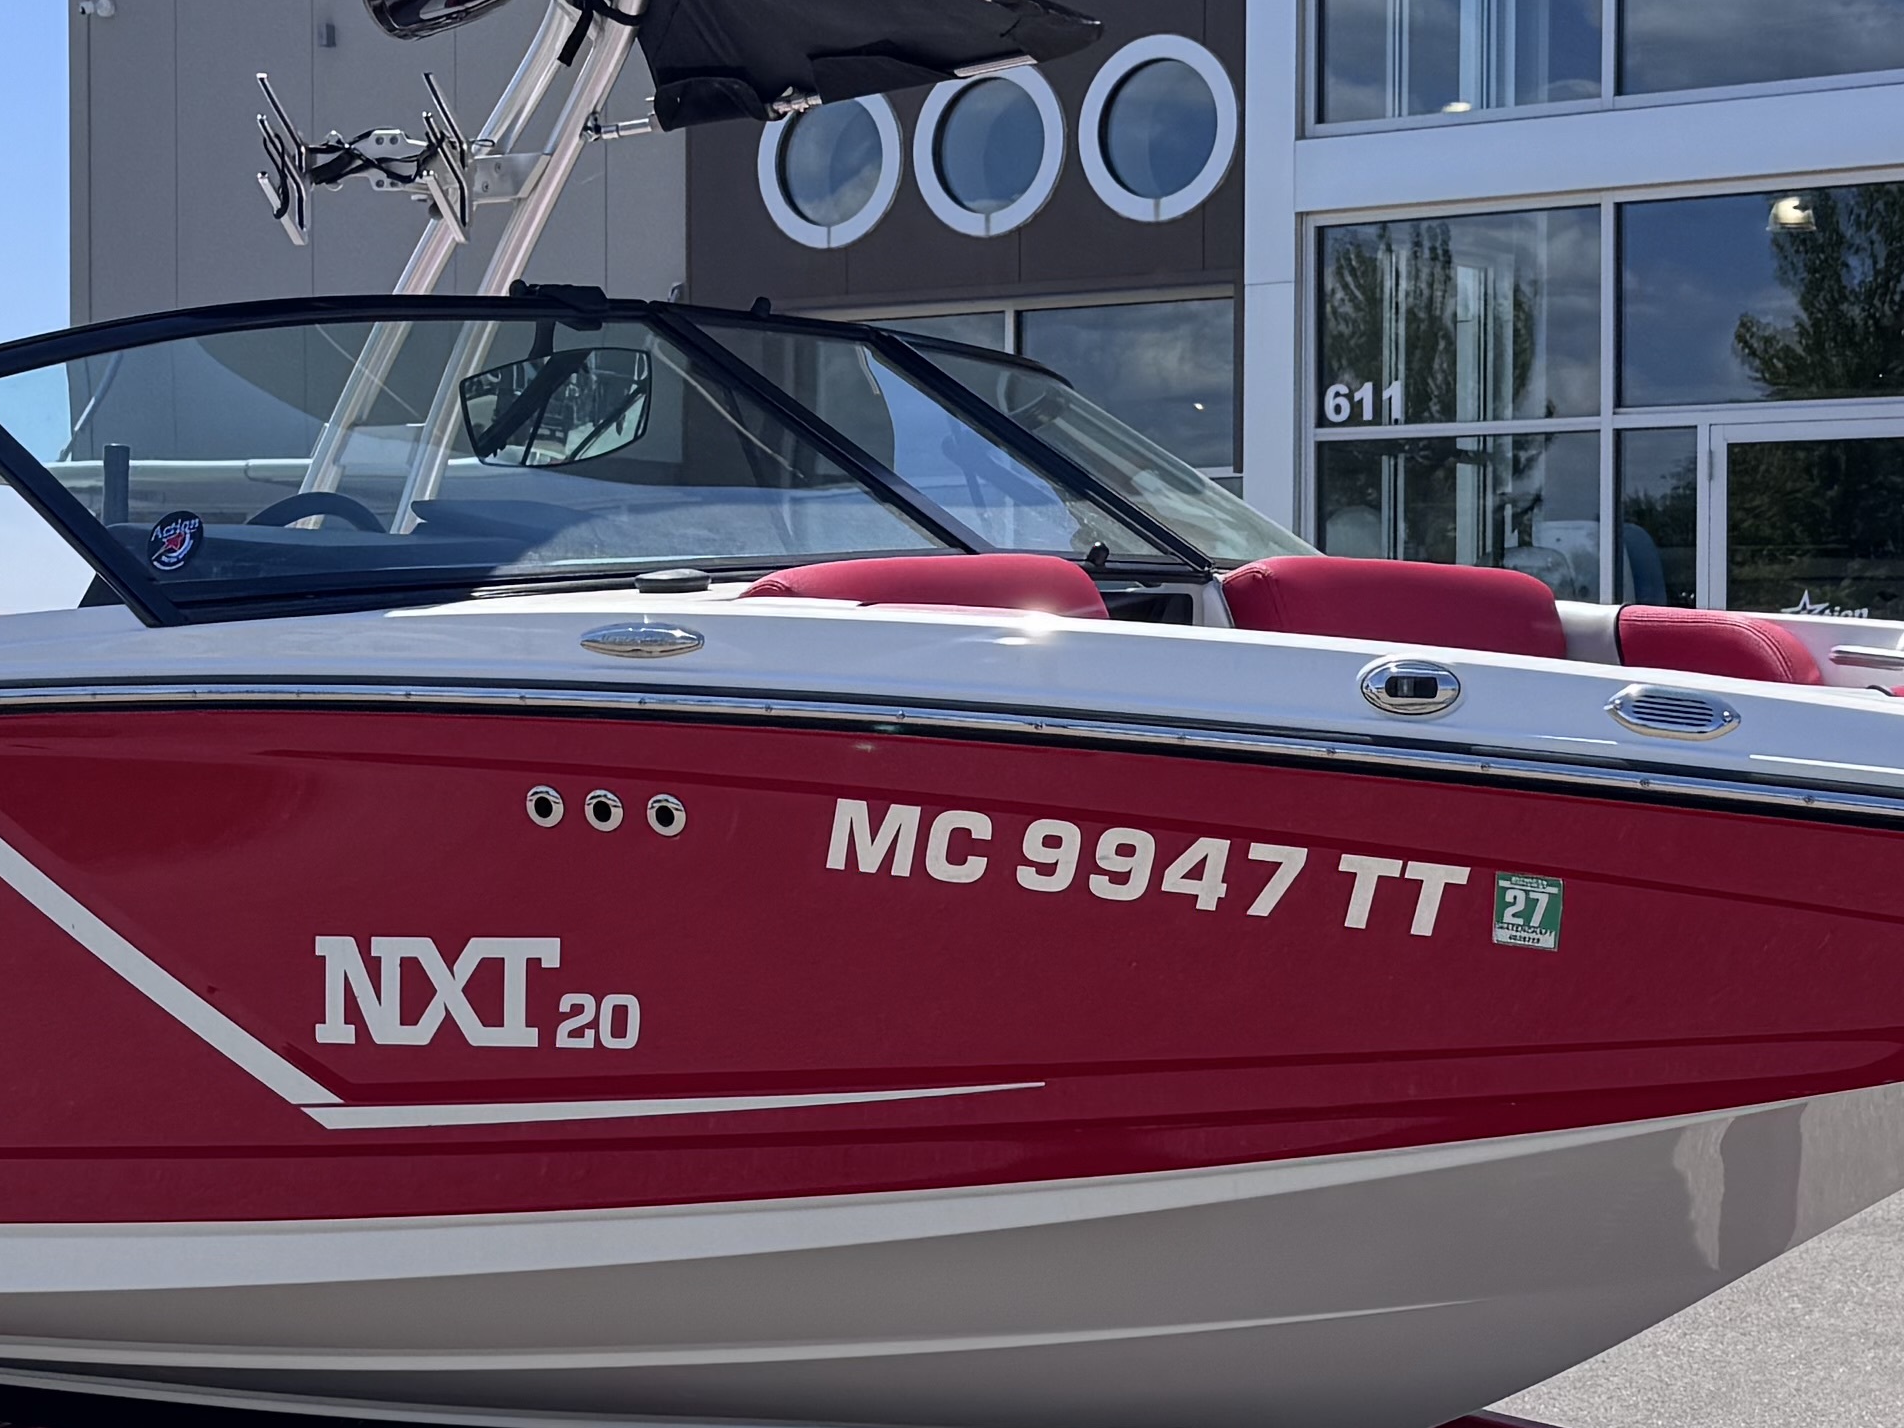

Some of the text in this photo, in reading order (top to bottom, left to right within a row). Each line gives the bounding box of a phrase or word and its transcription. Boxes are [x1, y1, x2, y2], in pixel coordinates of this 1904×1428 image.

[1324, 380, 1402, 422] 611
[825, 798, 1471, 936] MC 9947 TT
[1503, 888, 1549, 927] 27
[315, 935, 641, 1049] NXT 20
